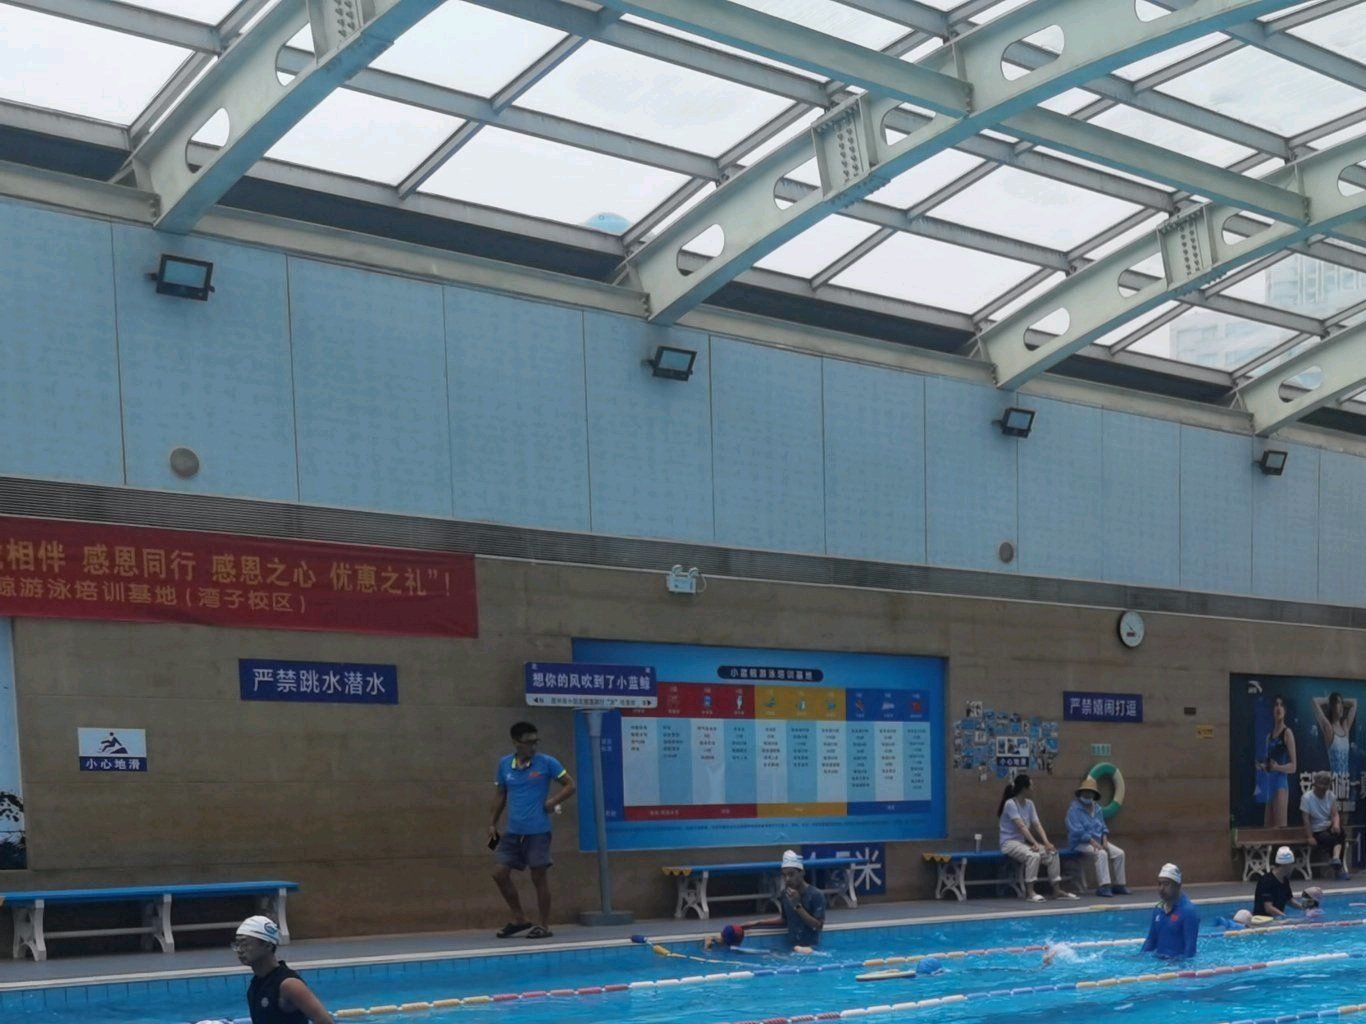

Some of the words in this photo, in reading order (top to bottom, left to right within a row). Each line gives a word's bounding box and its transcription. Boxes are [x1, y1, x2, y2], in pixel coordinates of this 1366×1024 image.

[0, 538, 66, 573] 相伴
[82, 543, 197, 582] 感恩同行
[212, 553, 316, 589] 感恩之心
[252, 667, 386, 697] 严禁跳水潜水
[532, 672, 651, 691] 想你的风吹到了小蓝鲸
[85, 756, 141, 771] 小心地滑
